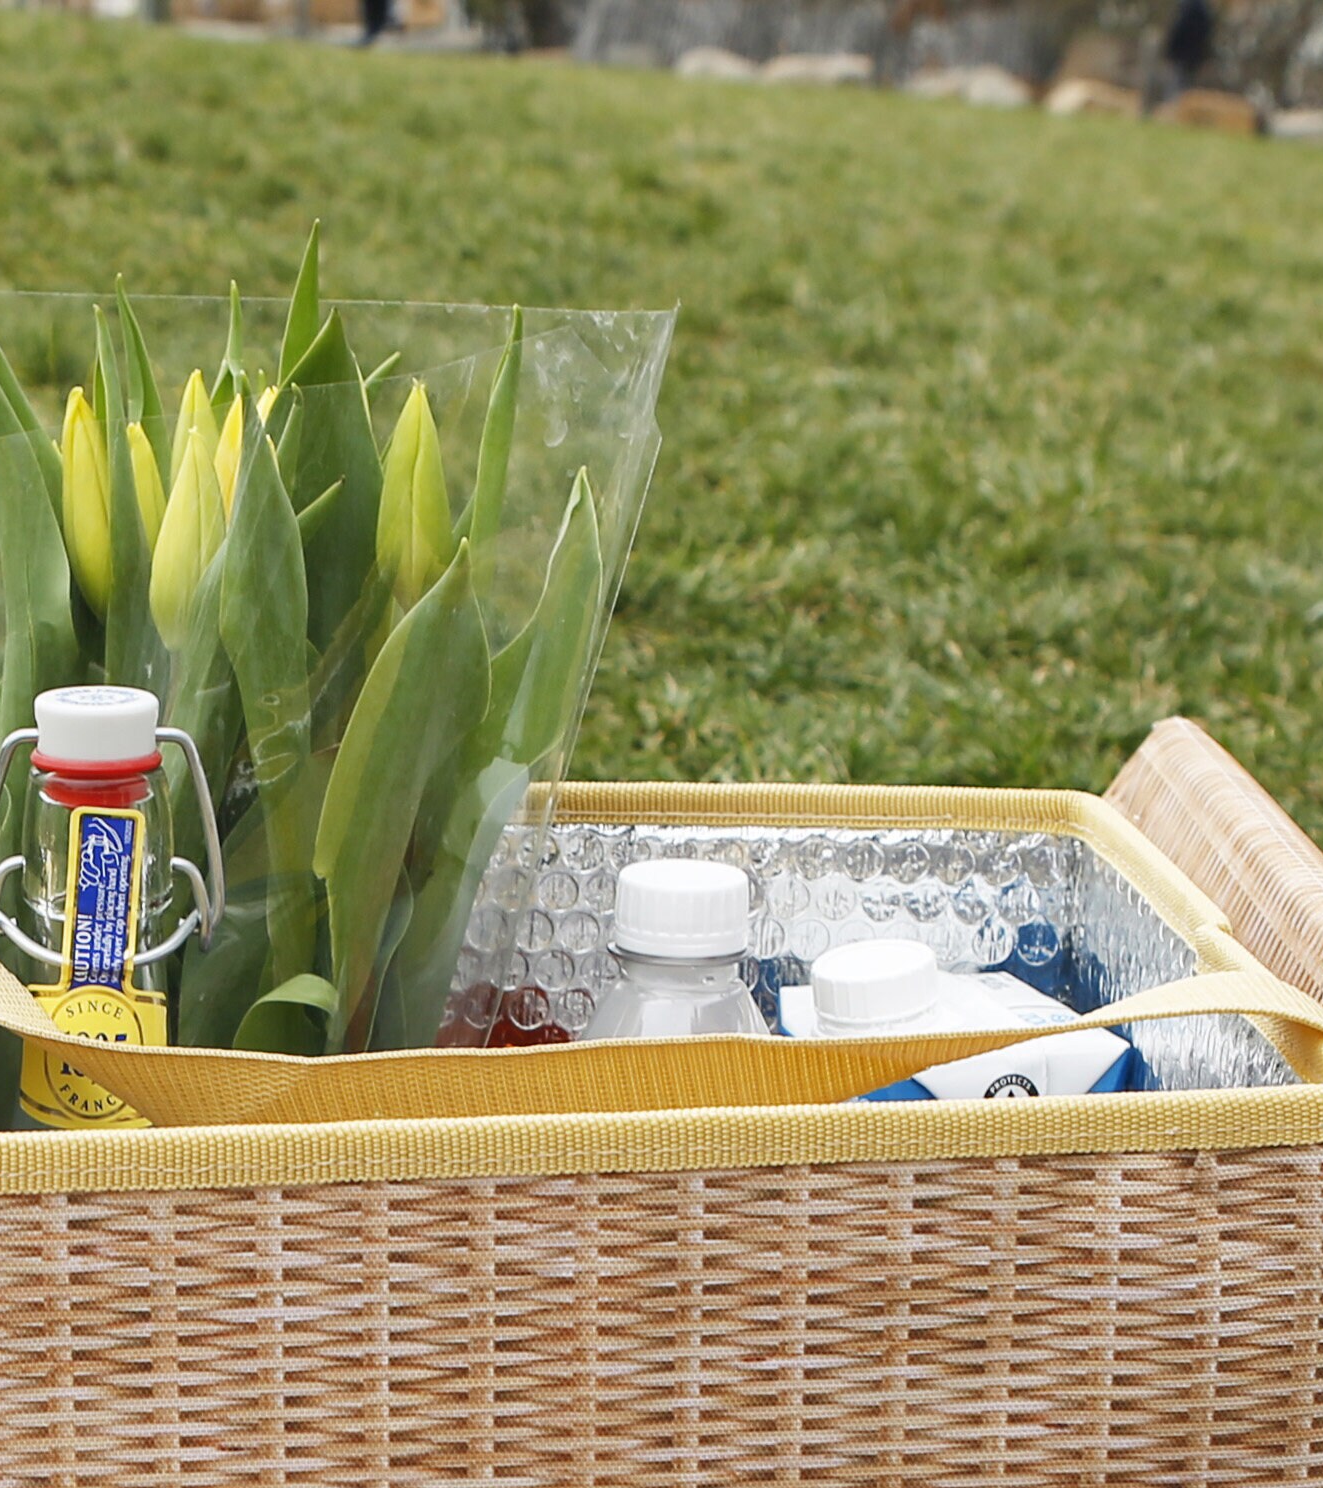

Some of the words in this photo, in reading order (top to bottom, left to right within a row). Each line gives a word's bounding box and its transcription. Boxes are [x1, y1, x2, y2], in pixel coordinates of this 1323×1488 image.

[107, 868, 117, 889] hand
[105, 891, 117, 920] placing
[115, 894, 126, 917] when
[92, 923, 103, 950] under
[103, 921, 114, 932] by
[115, 919, 126, 935] cap
[101, 933, 114, 970] carefully
[113, 936, 122, 958] over
[66, 1000, 124, 1020] SINCE
[988, 1075, 1032, 1095] PROTECTS
[60, 1084, 117, 1112] FRANC
